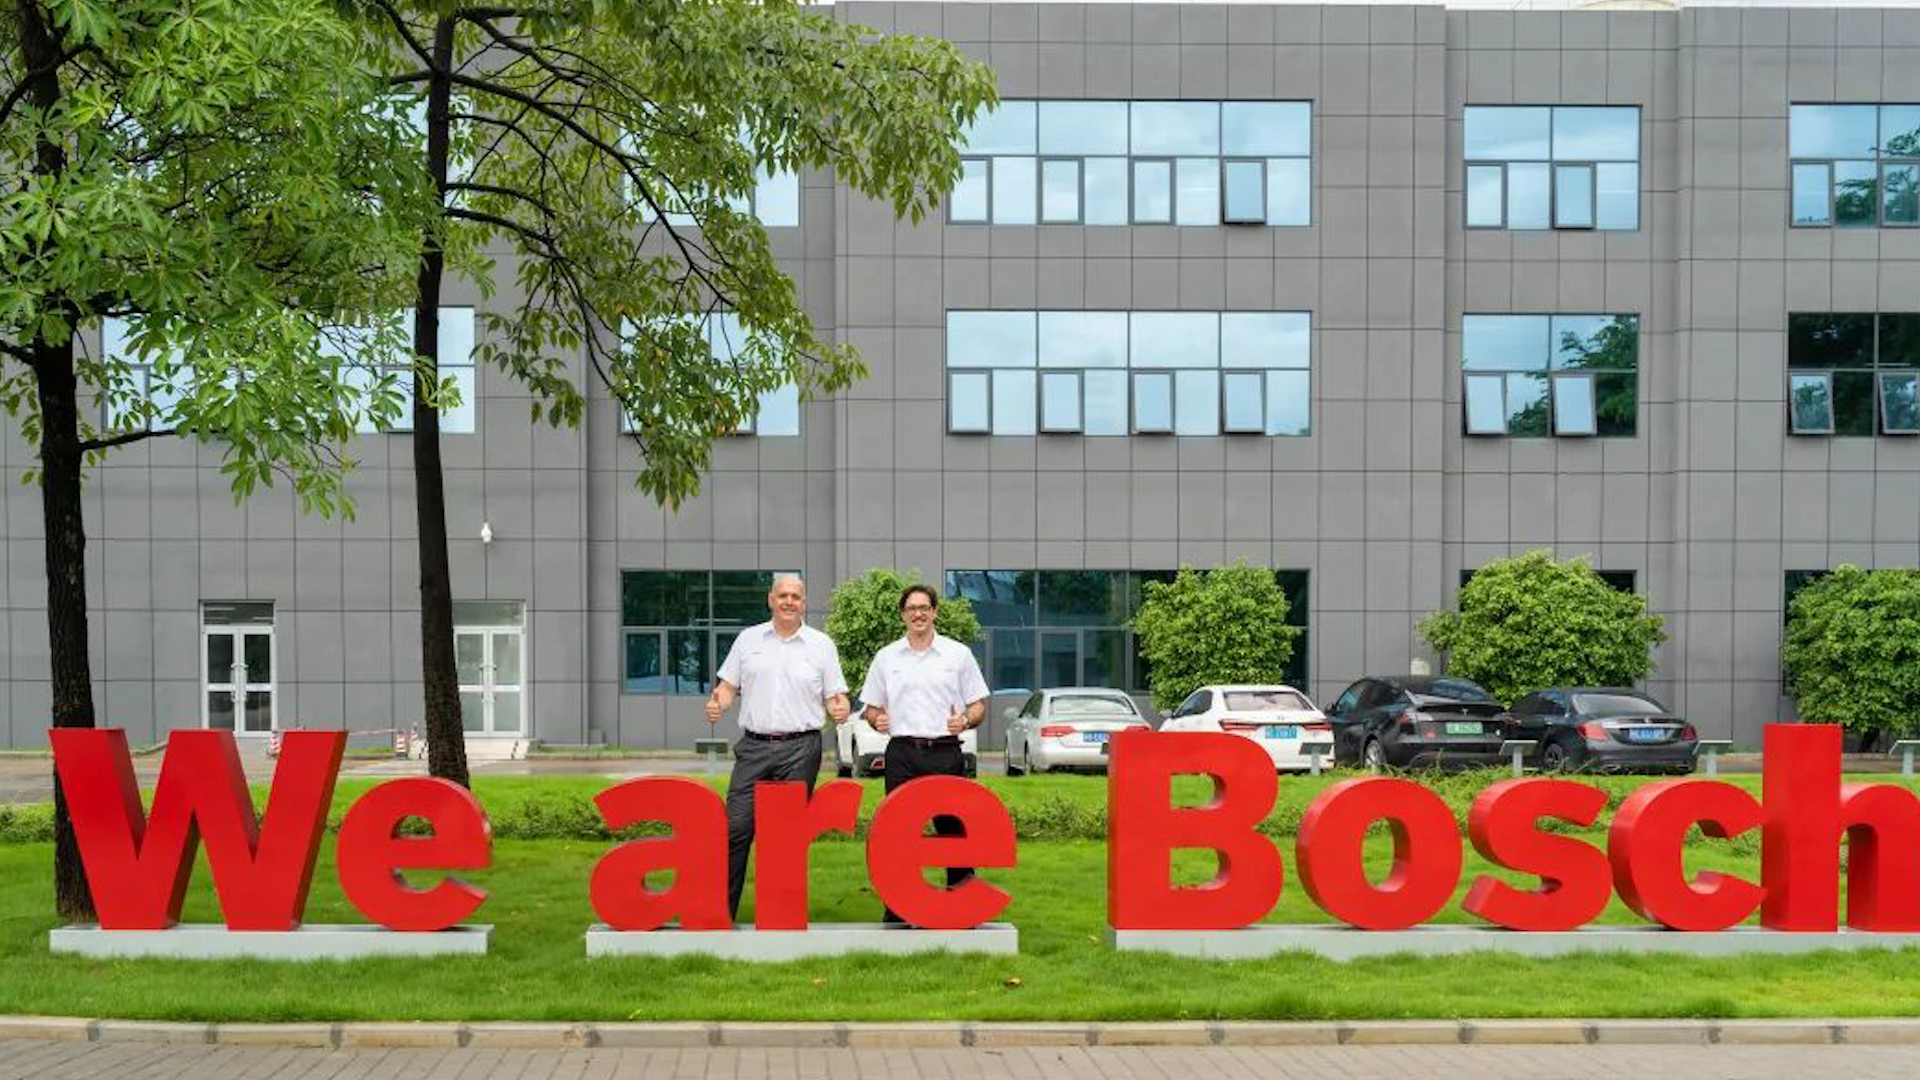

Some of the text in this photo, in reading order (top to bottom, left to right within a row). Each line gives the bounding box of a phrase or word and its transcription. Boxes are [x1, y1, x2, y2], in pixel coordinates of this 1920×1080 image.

[49, 723, 1920, 933] We are Bosch
